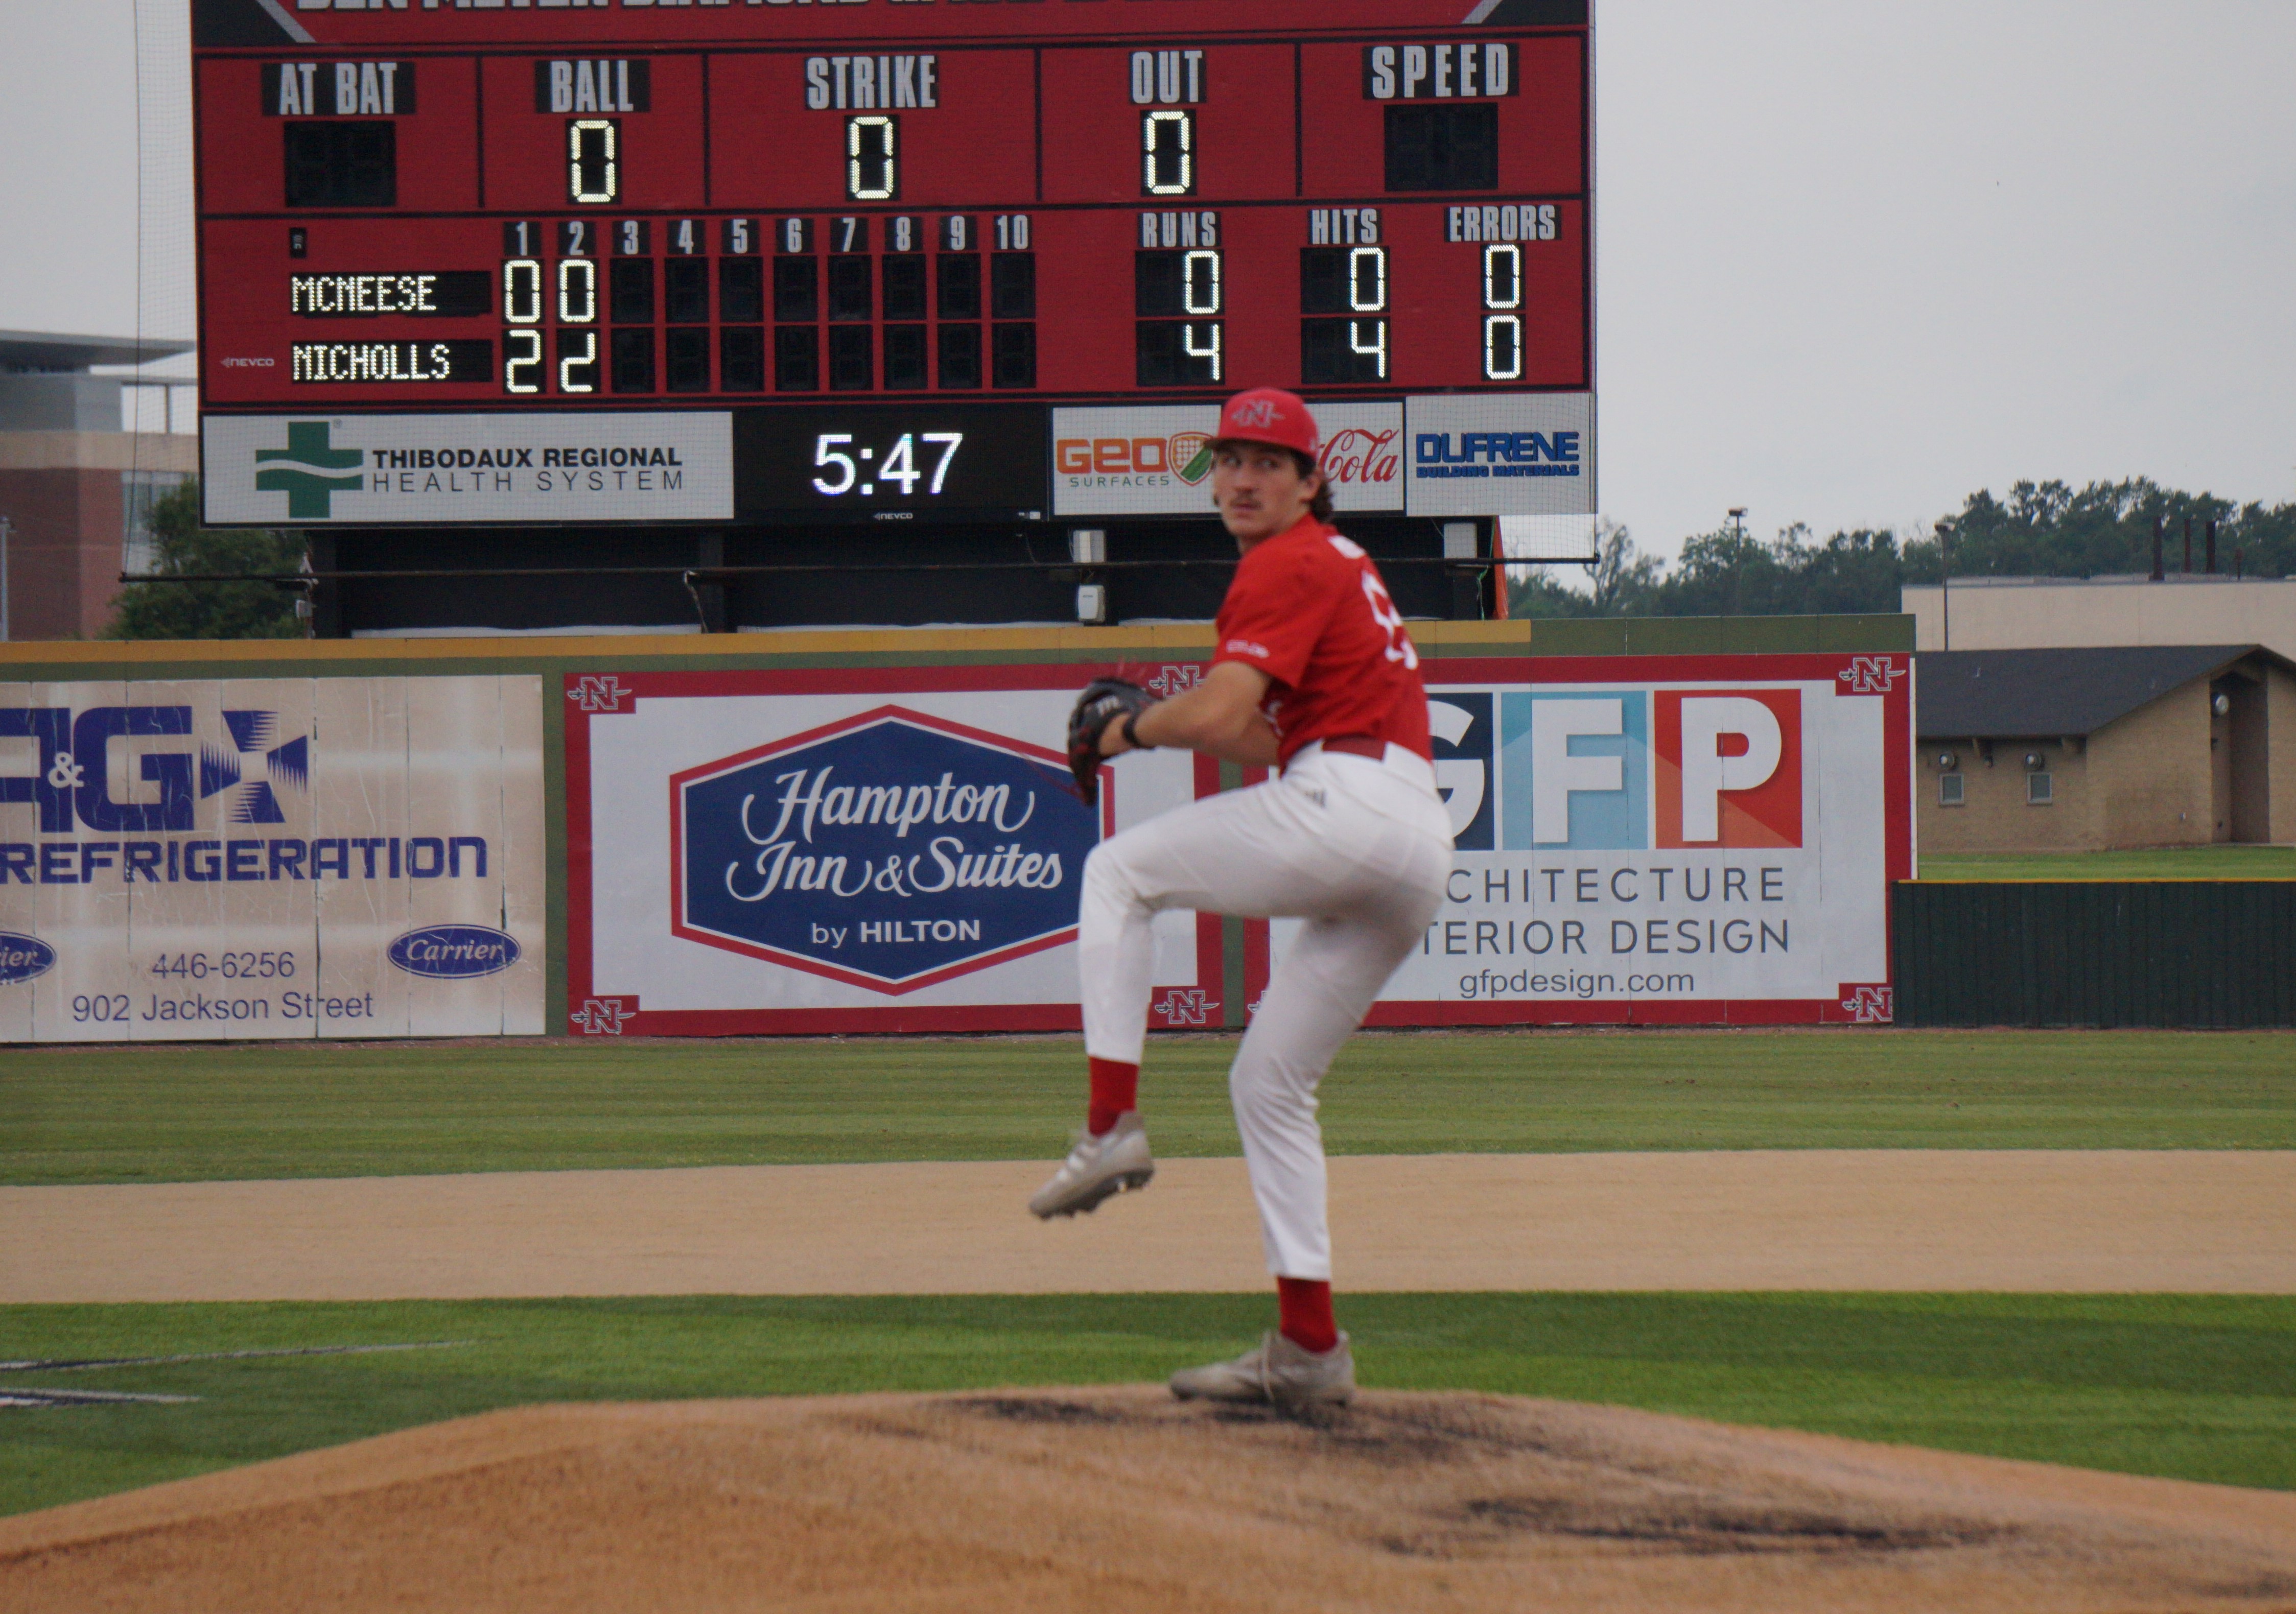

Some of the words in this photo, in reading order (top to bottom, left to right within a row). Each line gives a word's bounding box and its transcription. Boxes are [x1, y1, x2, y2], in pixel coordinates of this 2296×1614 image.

[279, 63, 317, 115] AT
[336, 62, 397, 114] BAT
[551, 60, 634, 113] BALL
[807, 55, 935, 109] STRIKE
[1132, 50, 1202, 104] OUT
[1372, 43, 1509, 99] SPEED
[571, 120, 615, 203] 0
[849, 116, 894, 199] 0
[1146, 111, 1190, 194] 0
[517, 221, 528, 256] 1
[569, 221, 584, 256] 2
[624, 220, 639, 255] 3
[678, 220, 694, 254] 4
[733, 219, 748, 254] 5
[787, 218, 802, 253] 6
[842, 217, 856, 252] 7
[896, 217, 911, 251] 8
[950, 216, 965, 250] 9
[997, 215, 1028, 250] 10
[1143, 211, 1215, 248] RUNS
[1312, 208, 1377, 245] HITS
[1449, 204, 1555, 242] ERRORS
[292, 275, 437, 312] MCNEESE
[505, 259, 540, 323] 0
[559, 259, 595, 322] 0
[1185, 250, 1219, 314] 0
[1350, 247, 1385, 312] 0
[1485, 244, 1520, 309] 0
[293, 344, 450, 380] NICHOLLS
[506, 329, 541, 393] 2
[1185, 324, 1220, 381] 4
[1351, 321, 1385, 378] 4
[1486, 315, 1520, 379] 0
[372, 448, 533, 469] THIBODAUX
[544, 447, 682, 467] REGIONAL
[813, 433, 963, 495] 5:47
[1416, 431, 1580, 463] DUFRENE
[1416, 465, 1489, 479] BUILDING
[1492, 464, 1580, 477] MATERIALS
[373, 471, 511, 492] HEALTH
[537, 470, 682, 491] SYSTEM
[1070, 476, 1169, 488] SURFACES
[742, 766, 1035, 845] Hampton
[0, 837, 487, 885] REFRIGERATION
[725, 841, 873, 901] Inn
[875, 855, 912, 897] &
[908, 836, 1063, 892] Suites
[1447, 867, 1783, 904] CHITECTURE
[407, 939, 503, 961] Carrier
[812, 922, 848, 949] by
[860, 919, 980, 943] HILTON
[1423, 920, 1587, 955] TERIOR
[1611, 919, 1788, 954] DESIGN
[151, 952, 295, 979] 446-6256
[1460, 969, 1694, 999] gfpdesign.com
[73, 994, 130, 1022] 902
[142, 993, 269, 1021] Jackson
[282, 991, 373, 1019] Street
